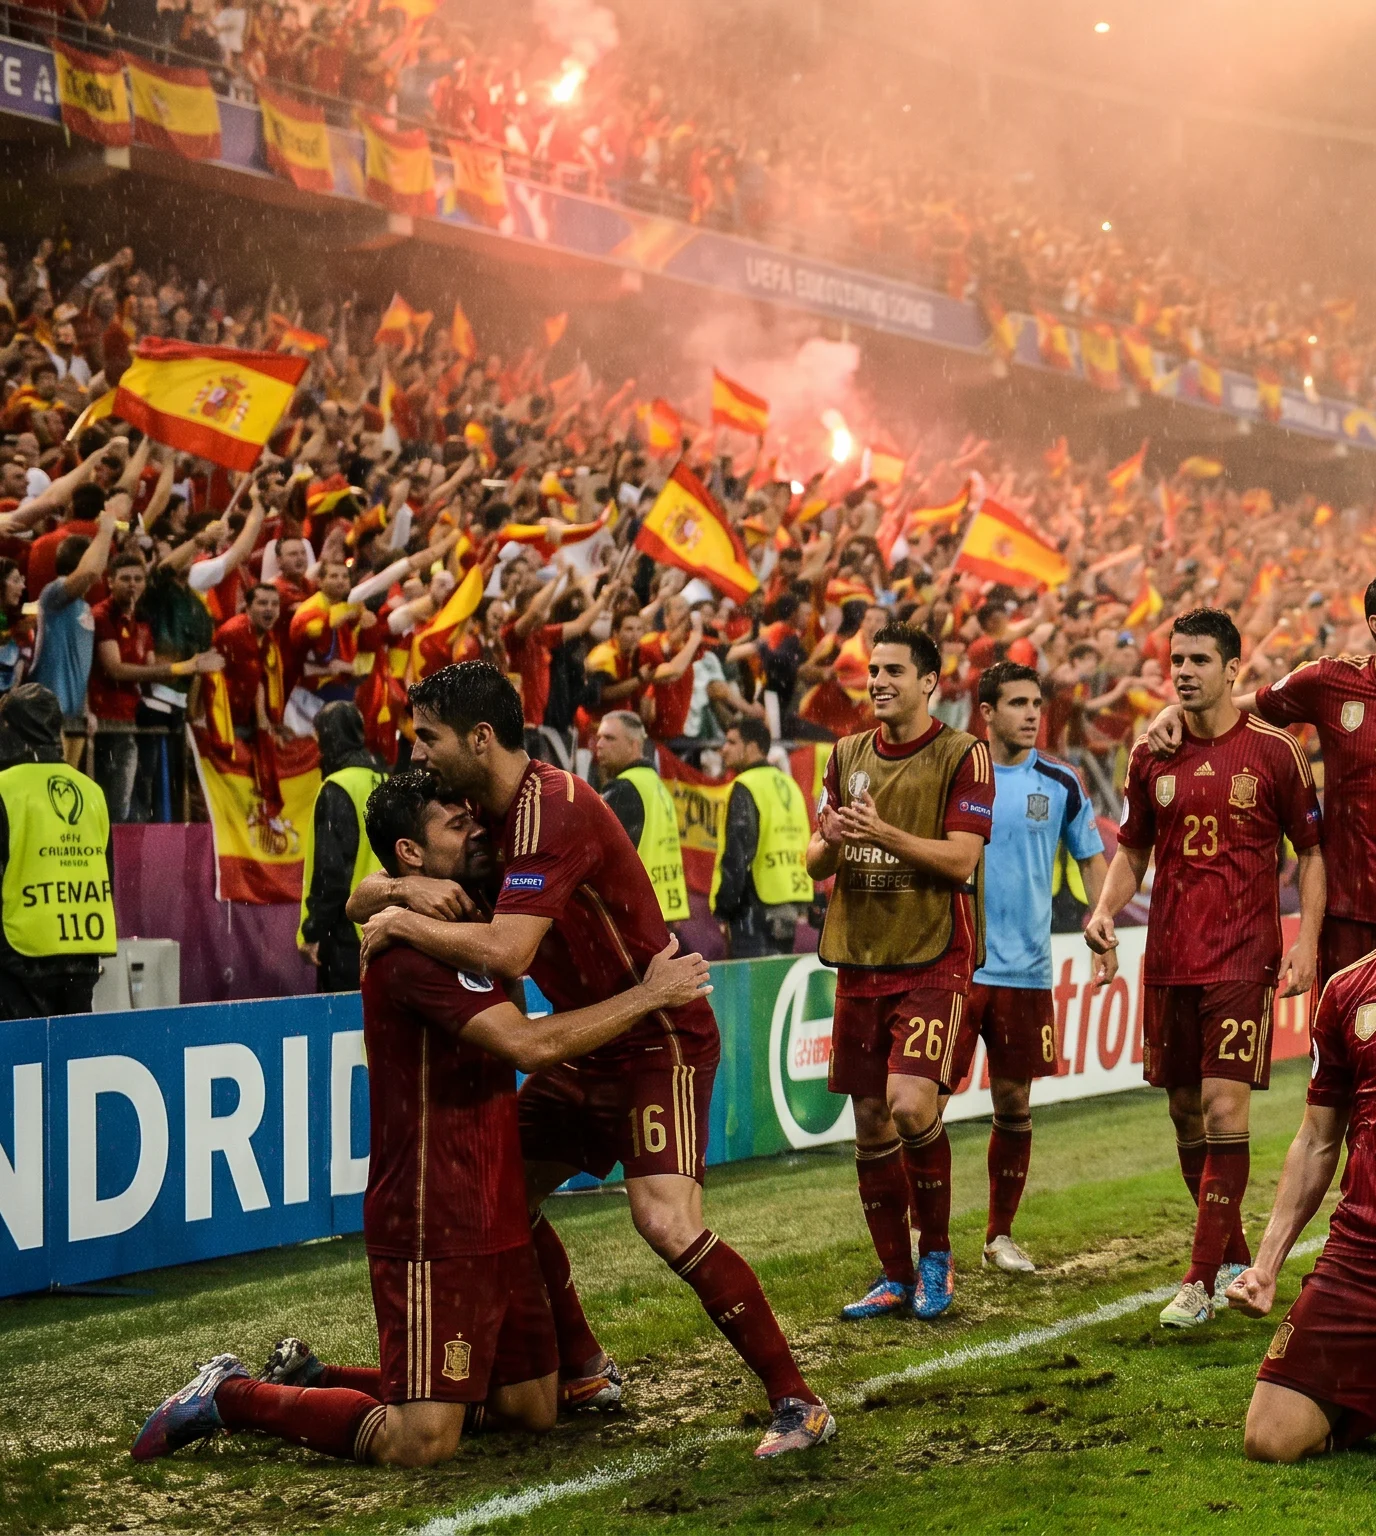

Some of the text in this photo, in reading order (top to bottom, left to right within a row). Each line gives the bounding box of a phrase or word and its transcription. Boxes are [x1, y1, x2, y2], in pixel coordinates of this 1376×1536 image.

[1183, 815, 1218, 857] 23
[57, 912, 104, 941] 110
[903, 1016, 944, 1061] 26
[1041, 1025, 1055, 1062] 8
[1218, 1018, 1258, 1062] 23
[628, 1104, 667, 1157] 16
